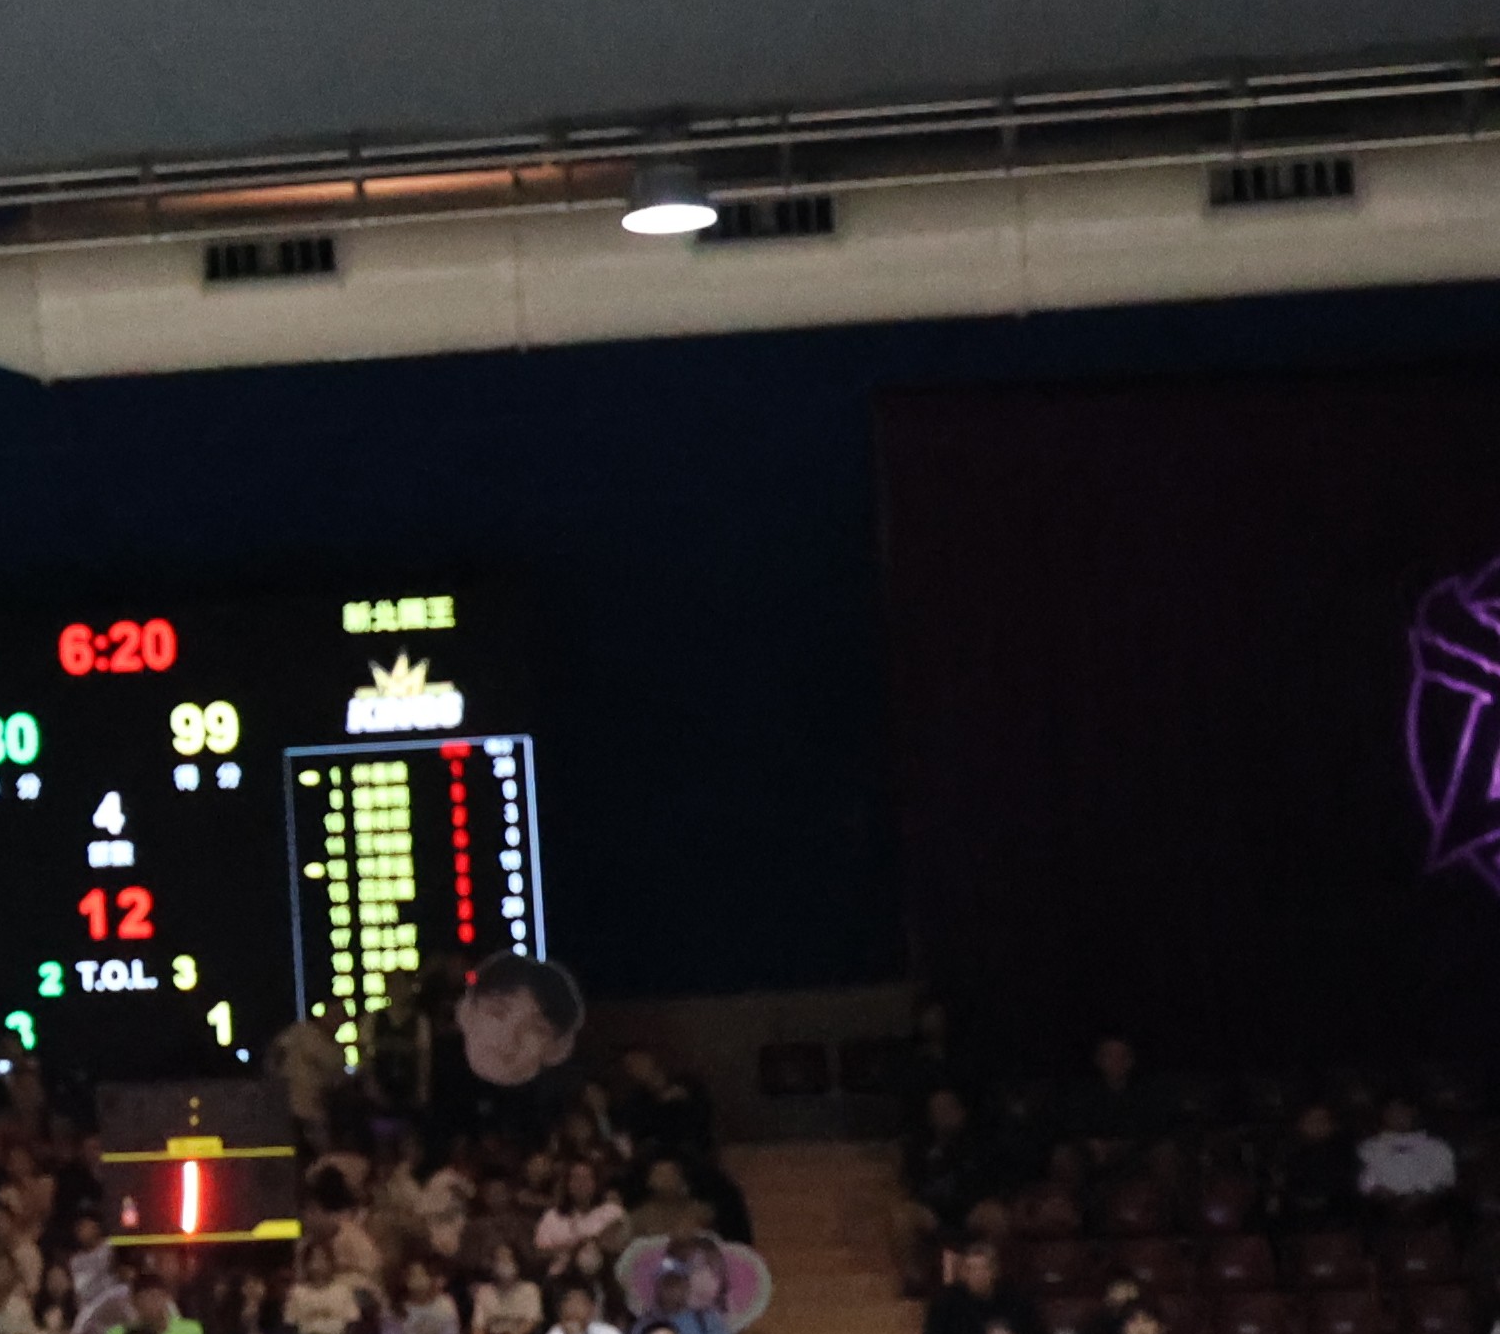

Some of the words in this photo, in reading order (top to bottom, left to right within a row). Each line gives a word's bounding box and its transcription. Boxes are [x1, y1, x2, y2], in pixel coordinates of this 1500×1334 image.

[58, 617, 178, 676] 6:20
[169, 700, 240, 756] 99
[92, 790, 126, 835] 4
[78, 885, 155, 941] 12
[38, 960, 64, 998] 2
[171, 954, 198, 991] 3
[206, 1000, 233, 1046] 1
